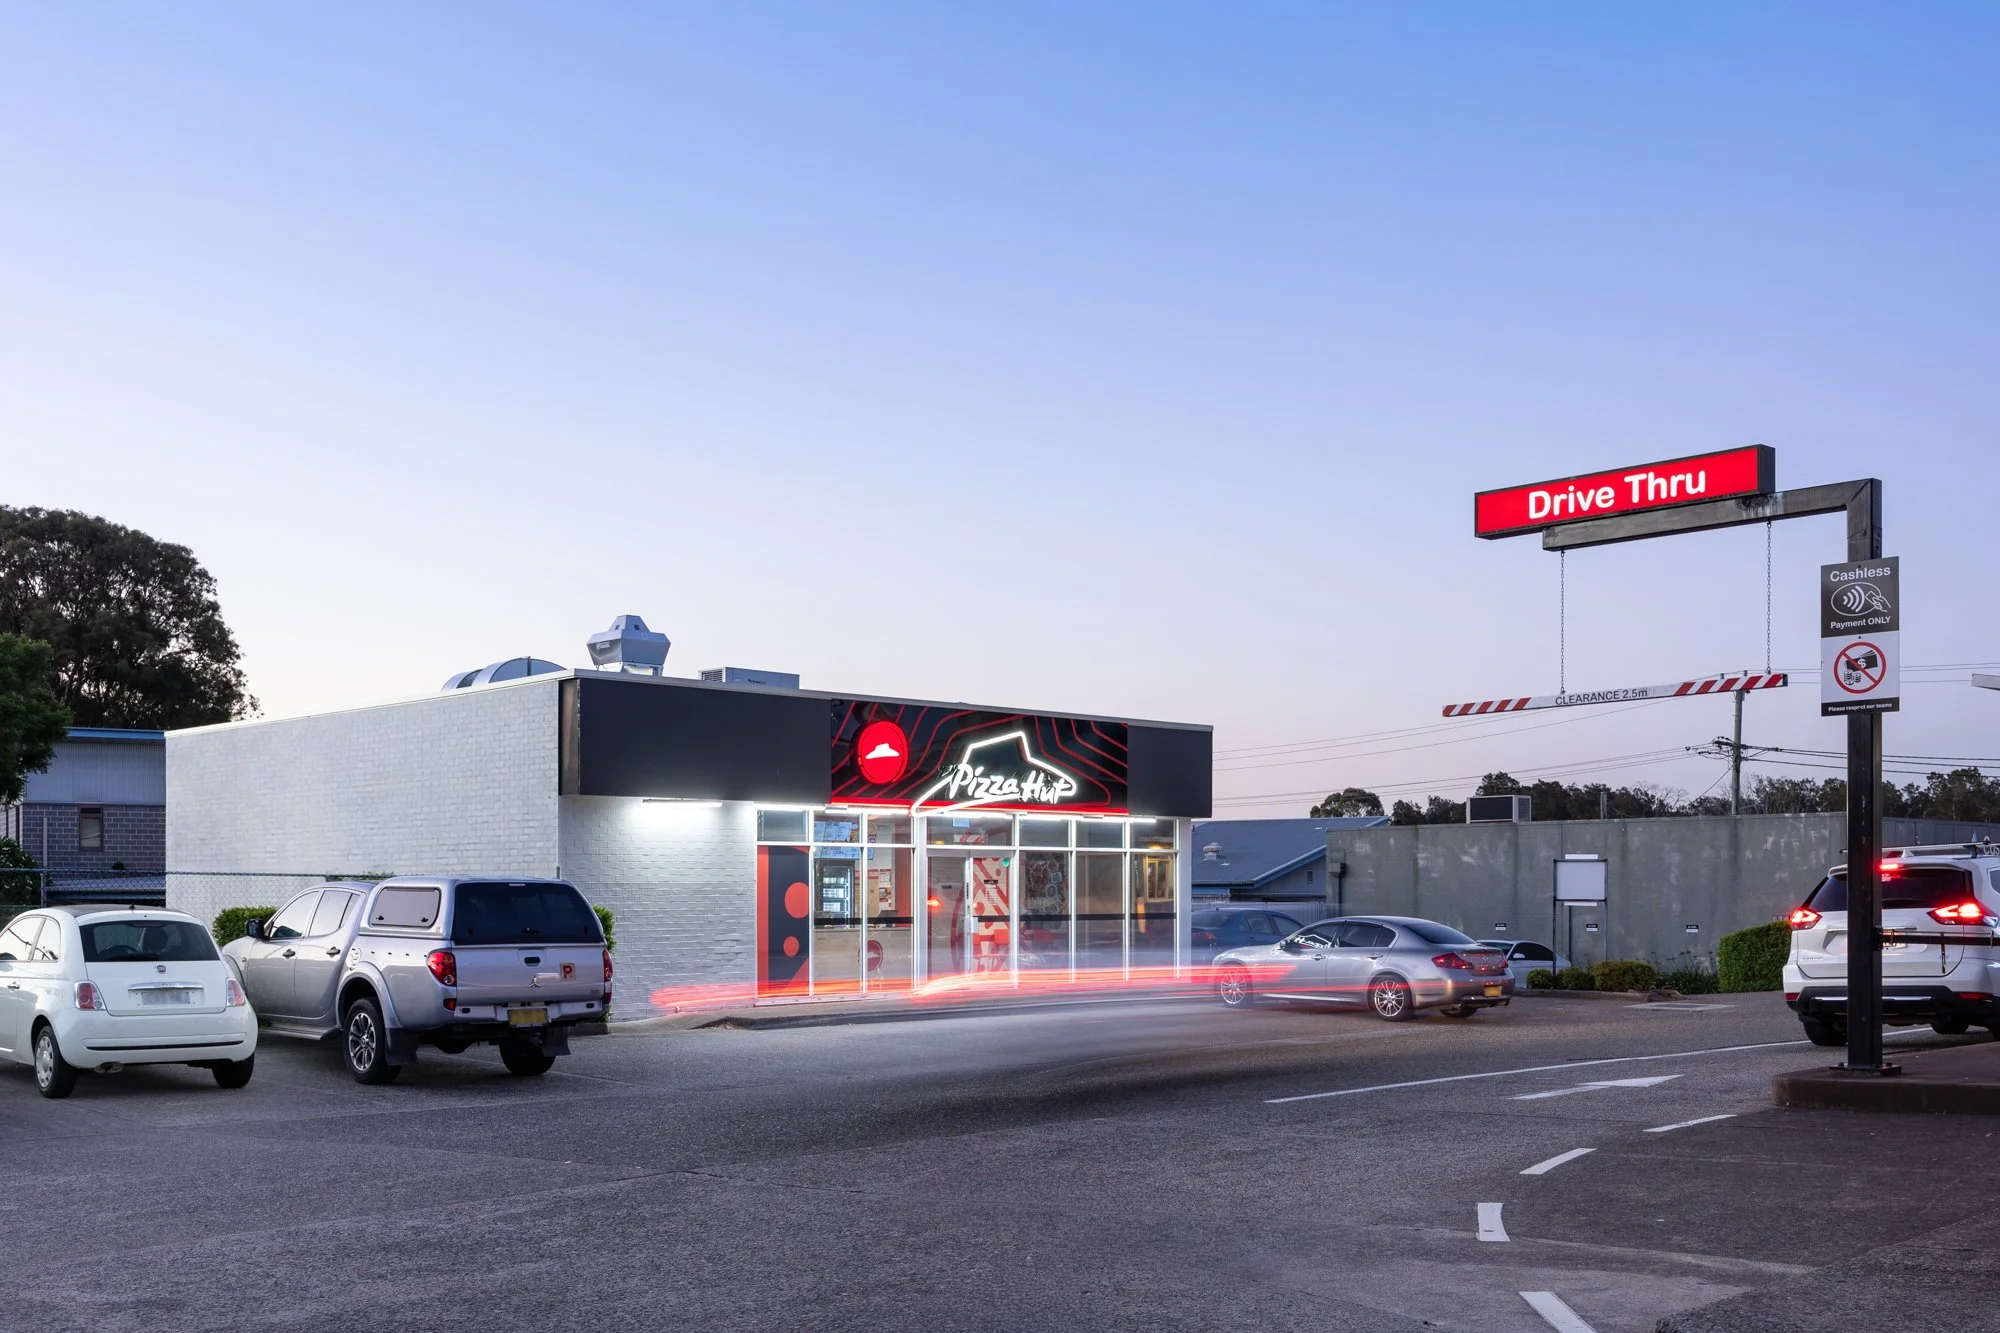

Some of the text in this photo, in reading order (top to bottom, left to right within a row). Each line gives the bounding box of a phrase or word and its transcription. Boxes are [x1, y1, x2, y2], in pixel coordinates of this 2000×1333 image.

[1528, 470, 1706, 520] Drive Thru
[1830, 567, 1891, 582] Cashless
[1830, 616, 1891, 630] Payment ONLY
[1555, 688, 1648, 706] CLEARANCE 2.5m
[949, 763, 1068, 805] Pizza Hut
[563, 965, 573, 979] P
